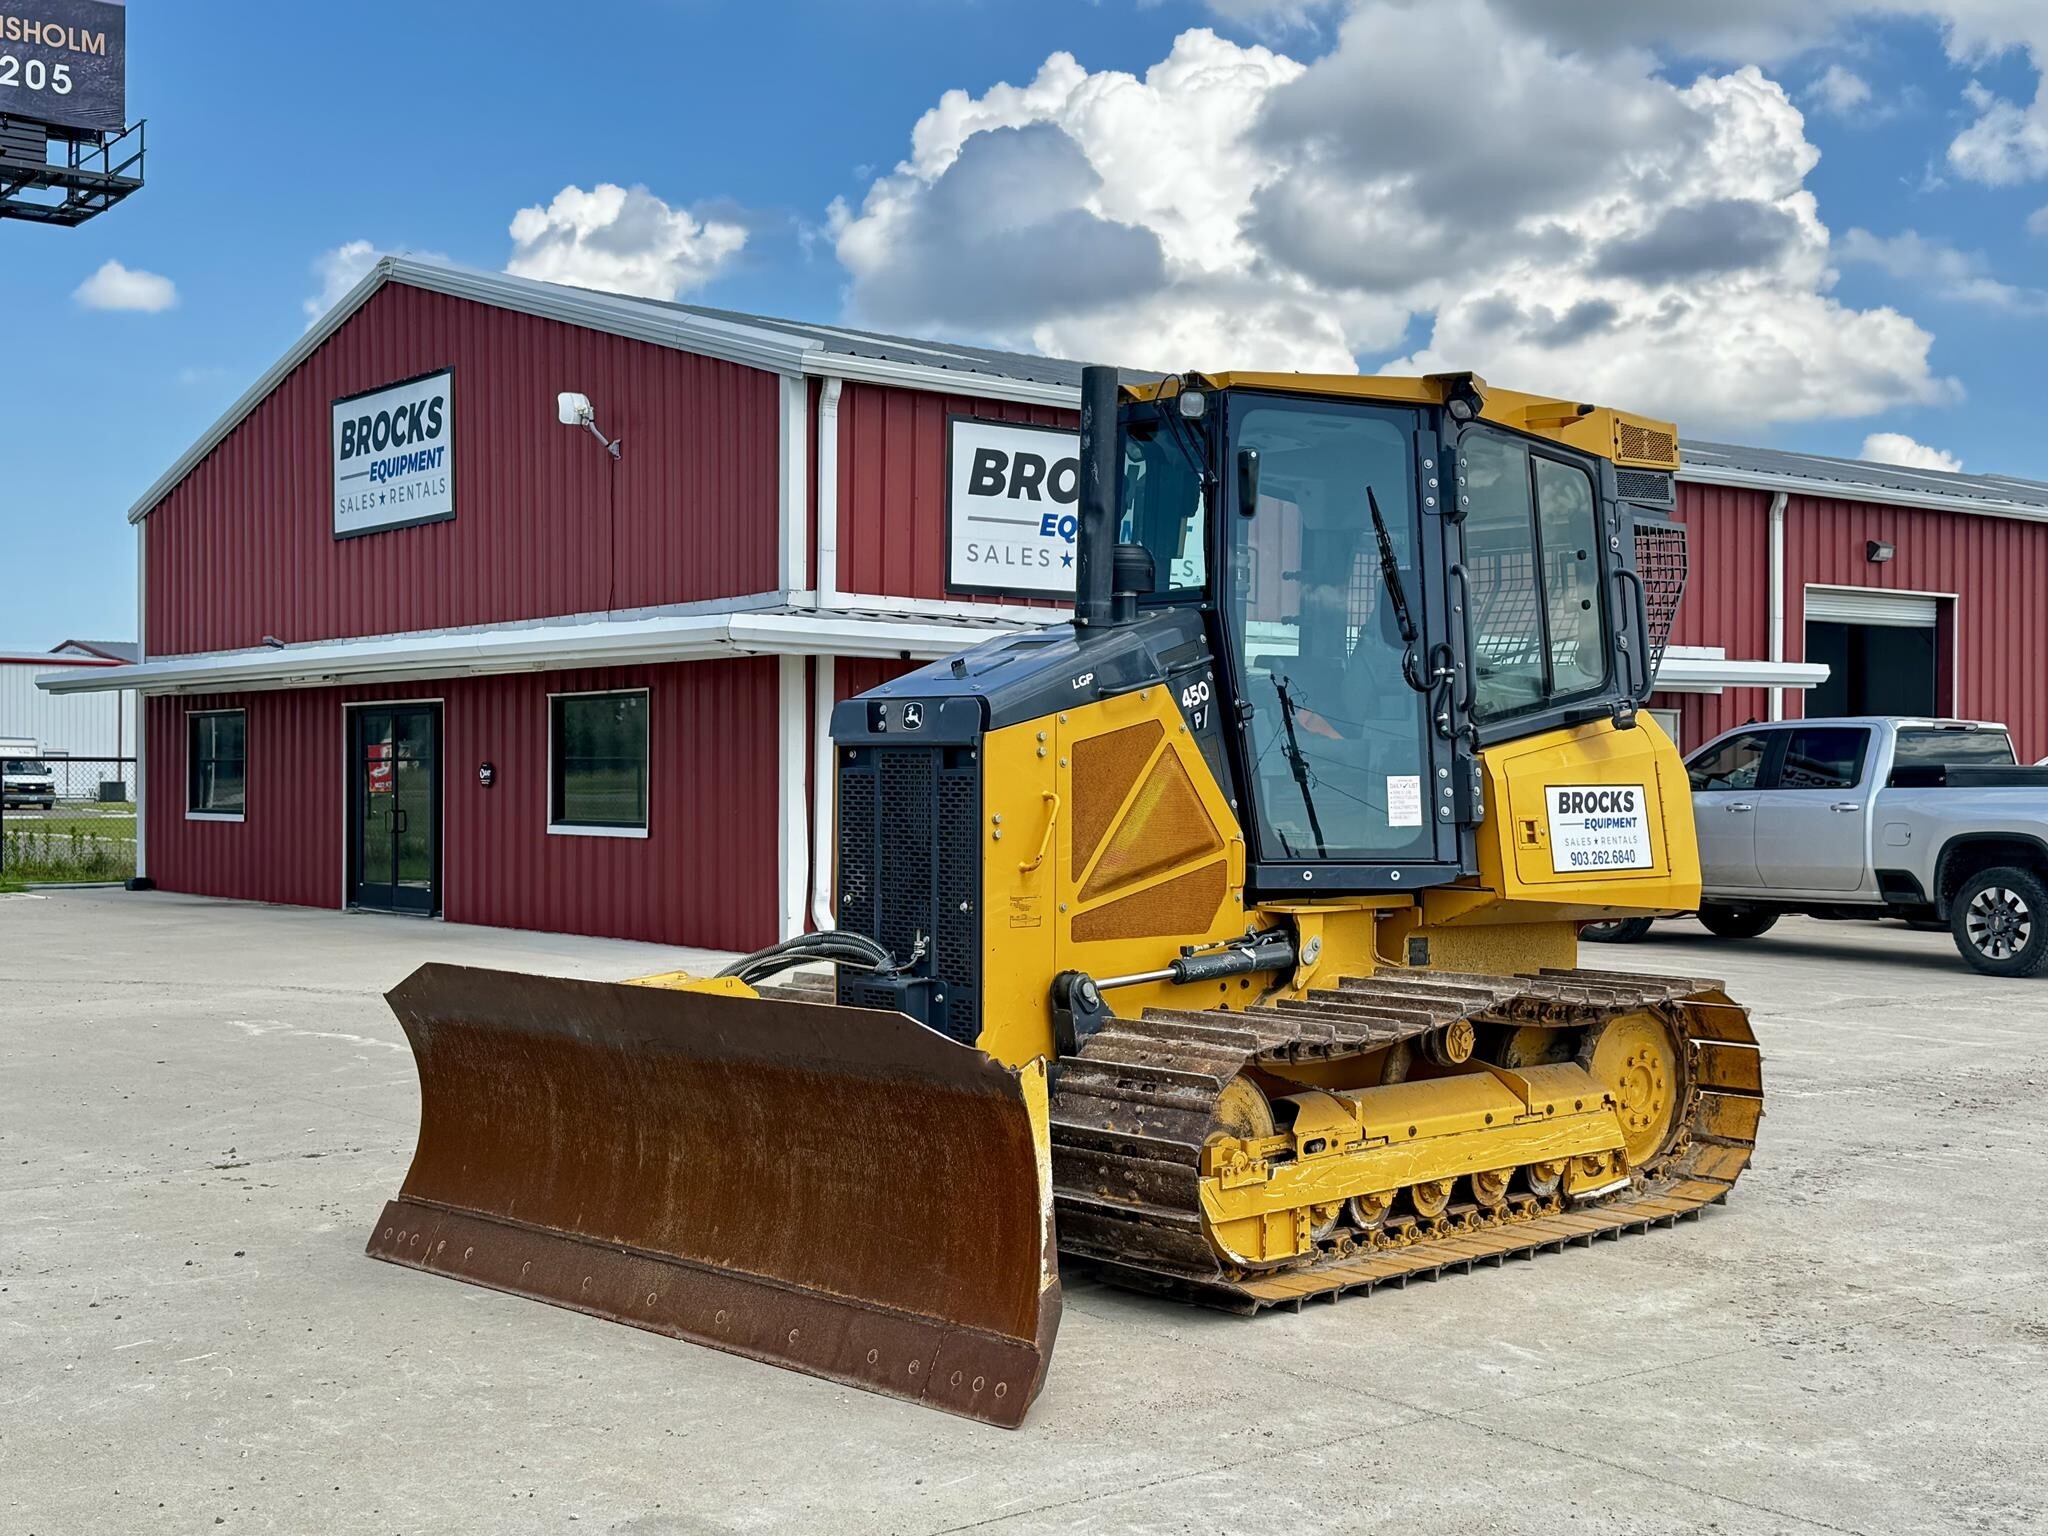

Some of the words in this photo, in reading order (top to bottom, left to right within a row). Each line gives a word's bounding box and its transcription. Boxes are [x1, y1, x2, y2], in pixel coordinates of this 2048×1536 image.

[0, 55, 72, 94] 205
[340, 396, 444, 461] BROCKS
[369, 446, 445, 484] EQUIPMENT
[340, 492, 375, 514] SALES
[390, 477, 446, 504] RENTALS
[966, 543, 1050, 567] SALES
[1072, 673, 1094, 690] LGP
[1182, 681, 1210, 709] 450
[1558, 791, 1634, 814] BROCKS
[1584, 817, 1638, 832] EQUIPMENT
[1564, 837, 1592, 847] SALES
[1601, 835, 1639, 846] RENTALS
[1570, 849, 1636, 866] 903.262.6840
